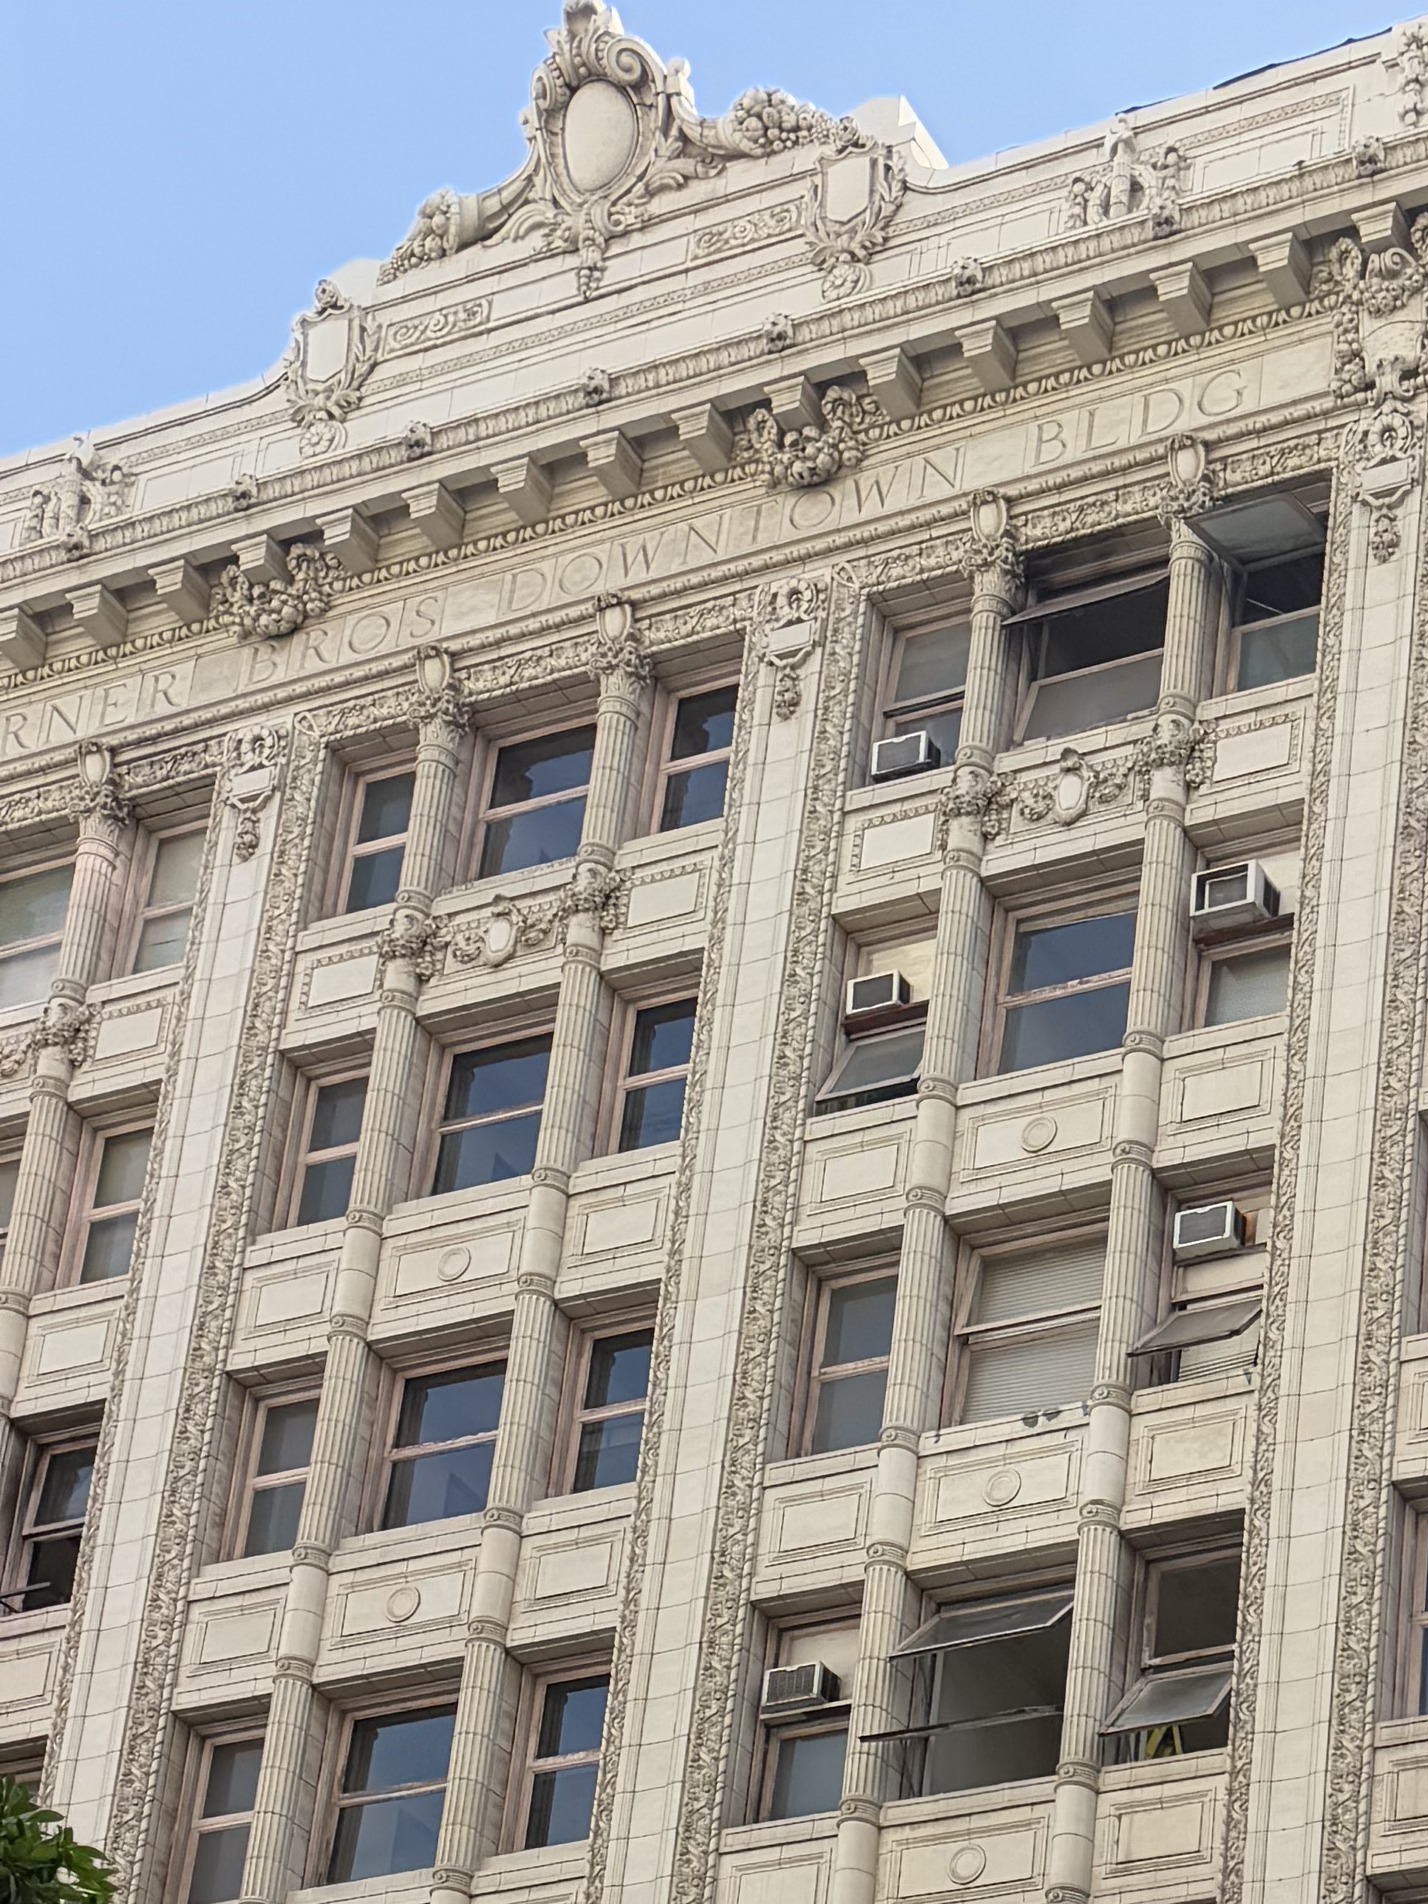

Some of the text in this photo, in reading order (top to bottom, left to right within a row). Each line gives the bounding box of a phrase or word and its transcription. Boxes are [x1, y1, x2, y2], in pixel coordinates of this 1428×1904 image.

[247, 596, 438, 687] BROS
[499, 446, 964, 616] DOWNTOWN
[1031, 369, 1248, 467] BLDG
